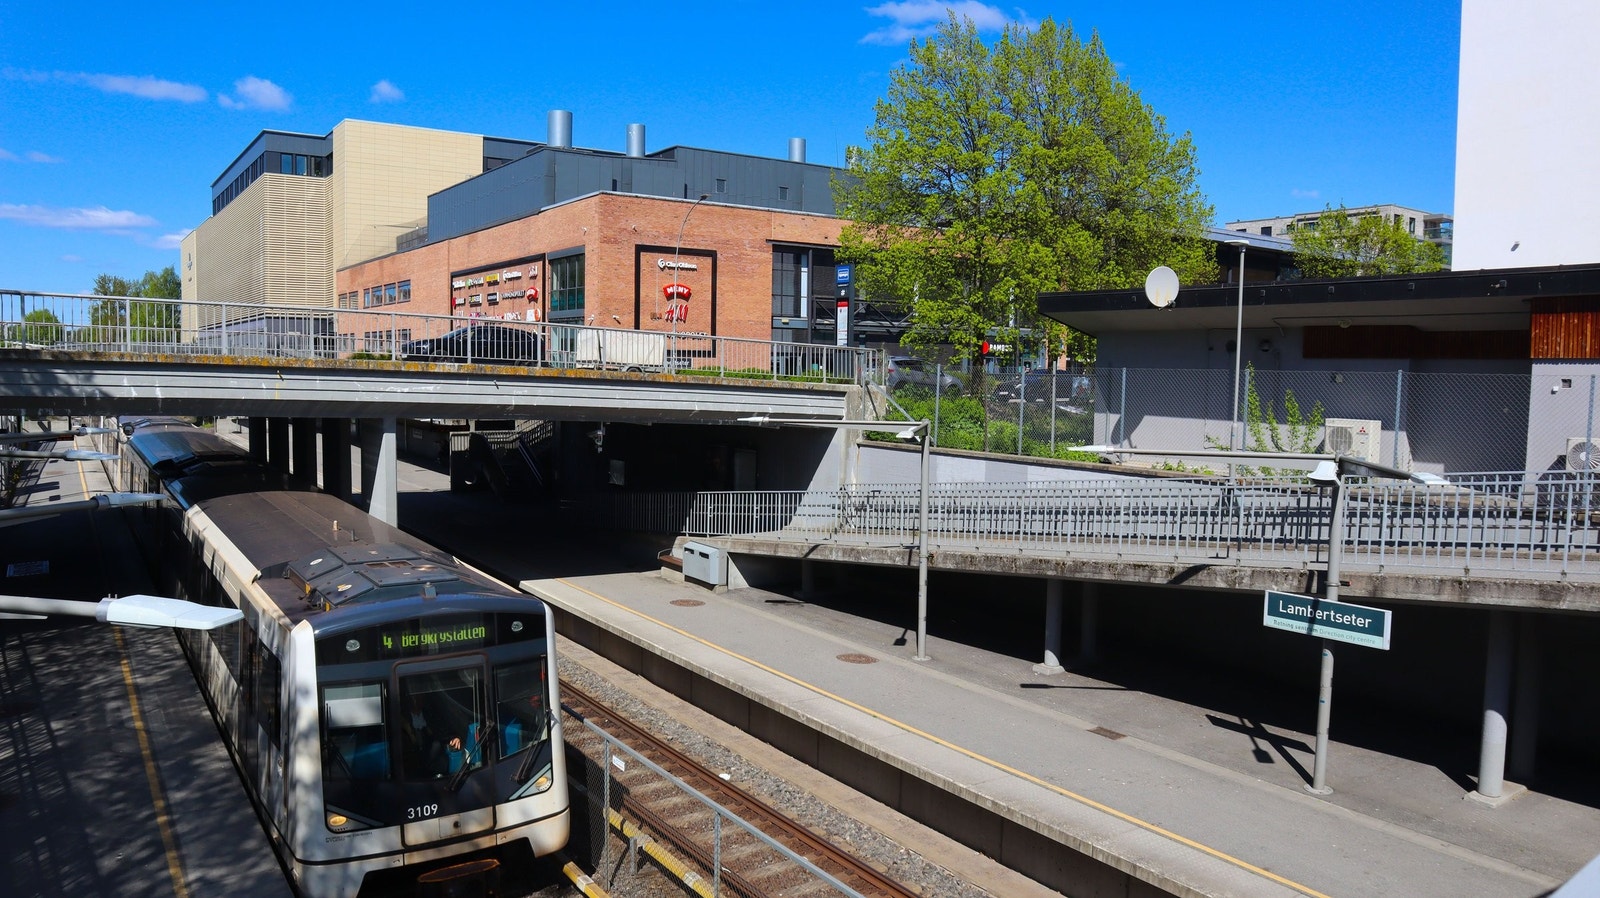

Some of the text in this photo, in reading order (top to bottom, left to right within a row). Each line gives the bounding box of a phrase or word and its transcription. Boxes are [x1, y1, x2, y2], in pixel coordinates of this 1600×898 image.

[665, 304, 688, 320] HM
[1279, 600, 1372, 628] Lambertseter
[1273, 619, 1294, 629] Retning
[1319, 628, 1345, 639] Direction
[1345, 634, 1356, 642] city
[1356, 636, 1377, 645] centre
[383, 635, 393, 649] 4
[407, 803, 438, 819] 3109
